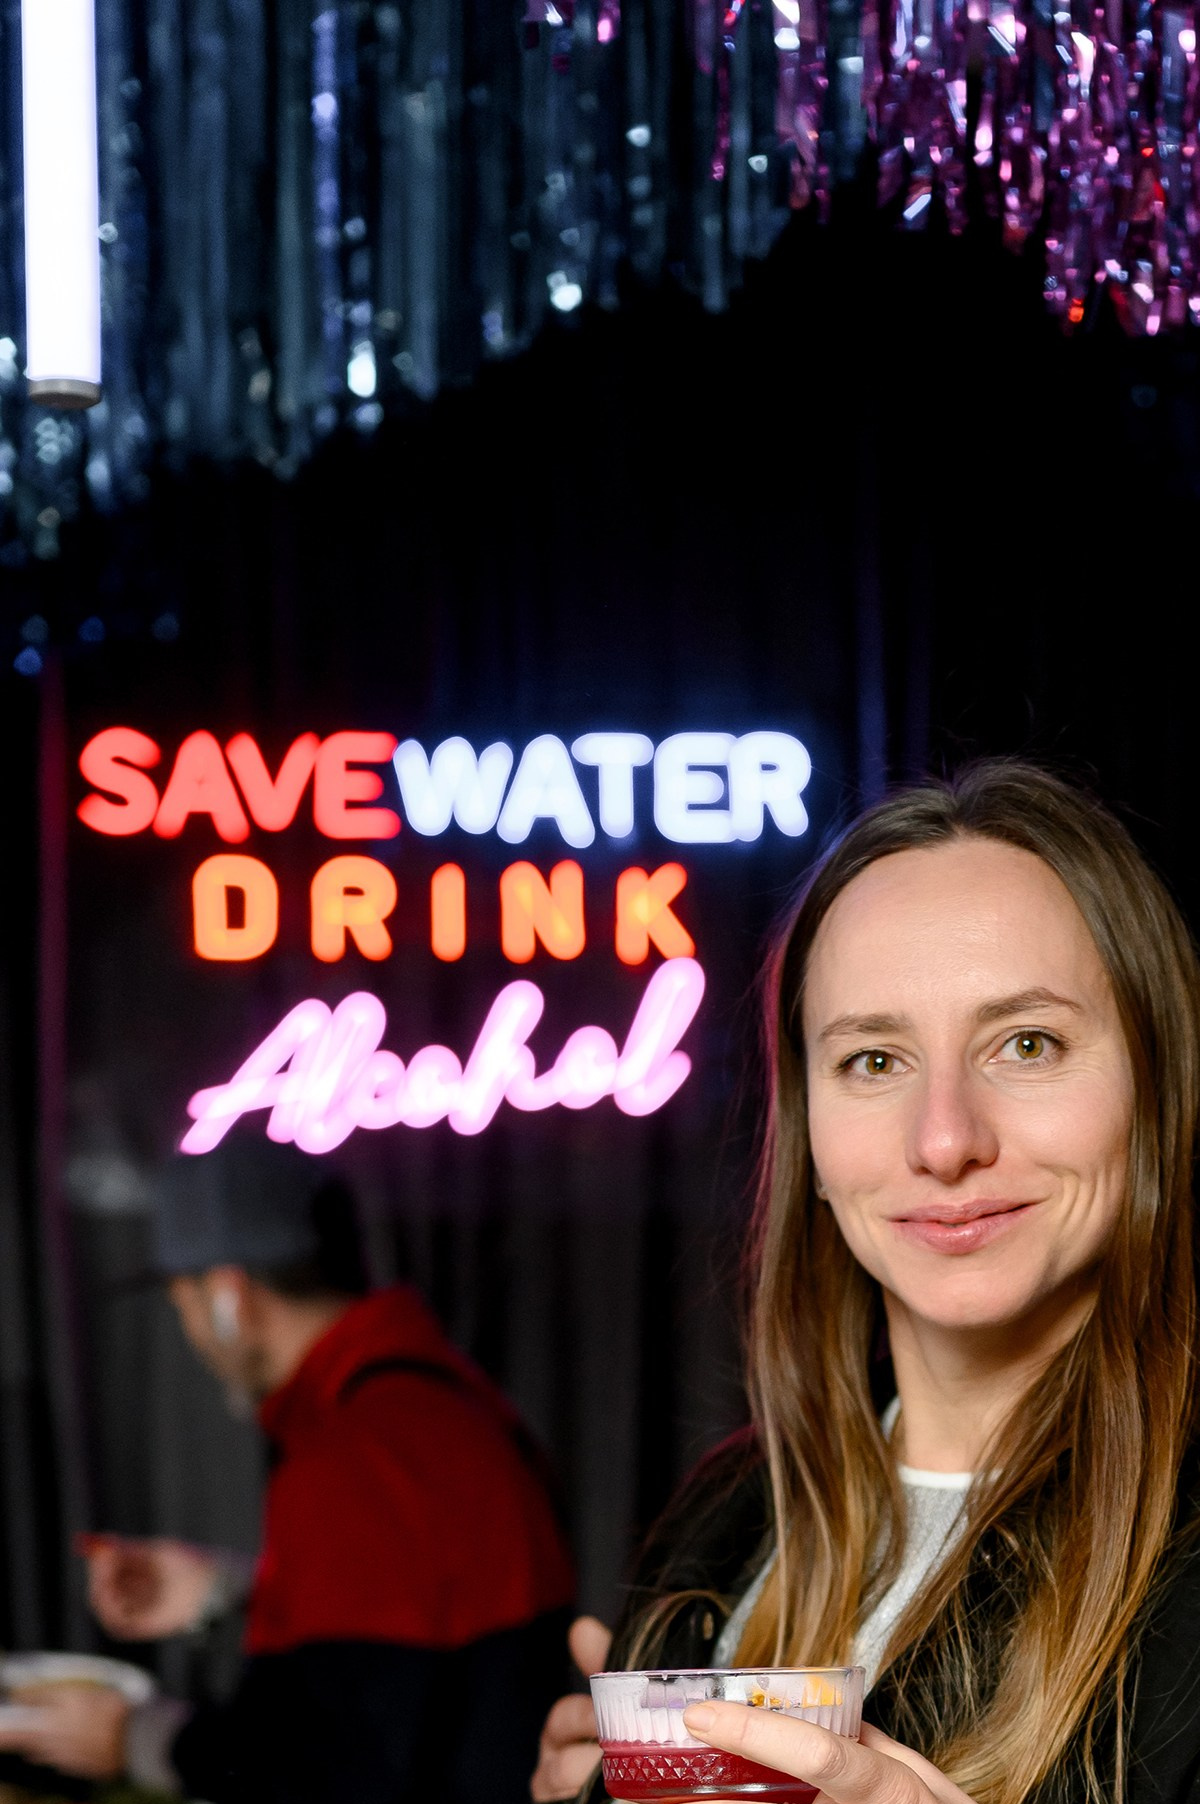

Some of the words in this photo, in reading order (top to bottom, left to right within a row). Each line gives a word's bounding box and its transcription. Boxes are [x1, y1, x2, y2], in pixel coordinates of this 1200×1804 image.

[78, 726, 397, 844] SAVE
[393, 731, 812, 849] WATER
[191, 853, 696, 965] DRINK
[179, 956, 706, 1156] Alcohol
